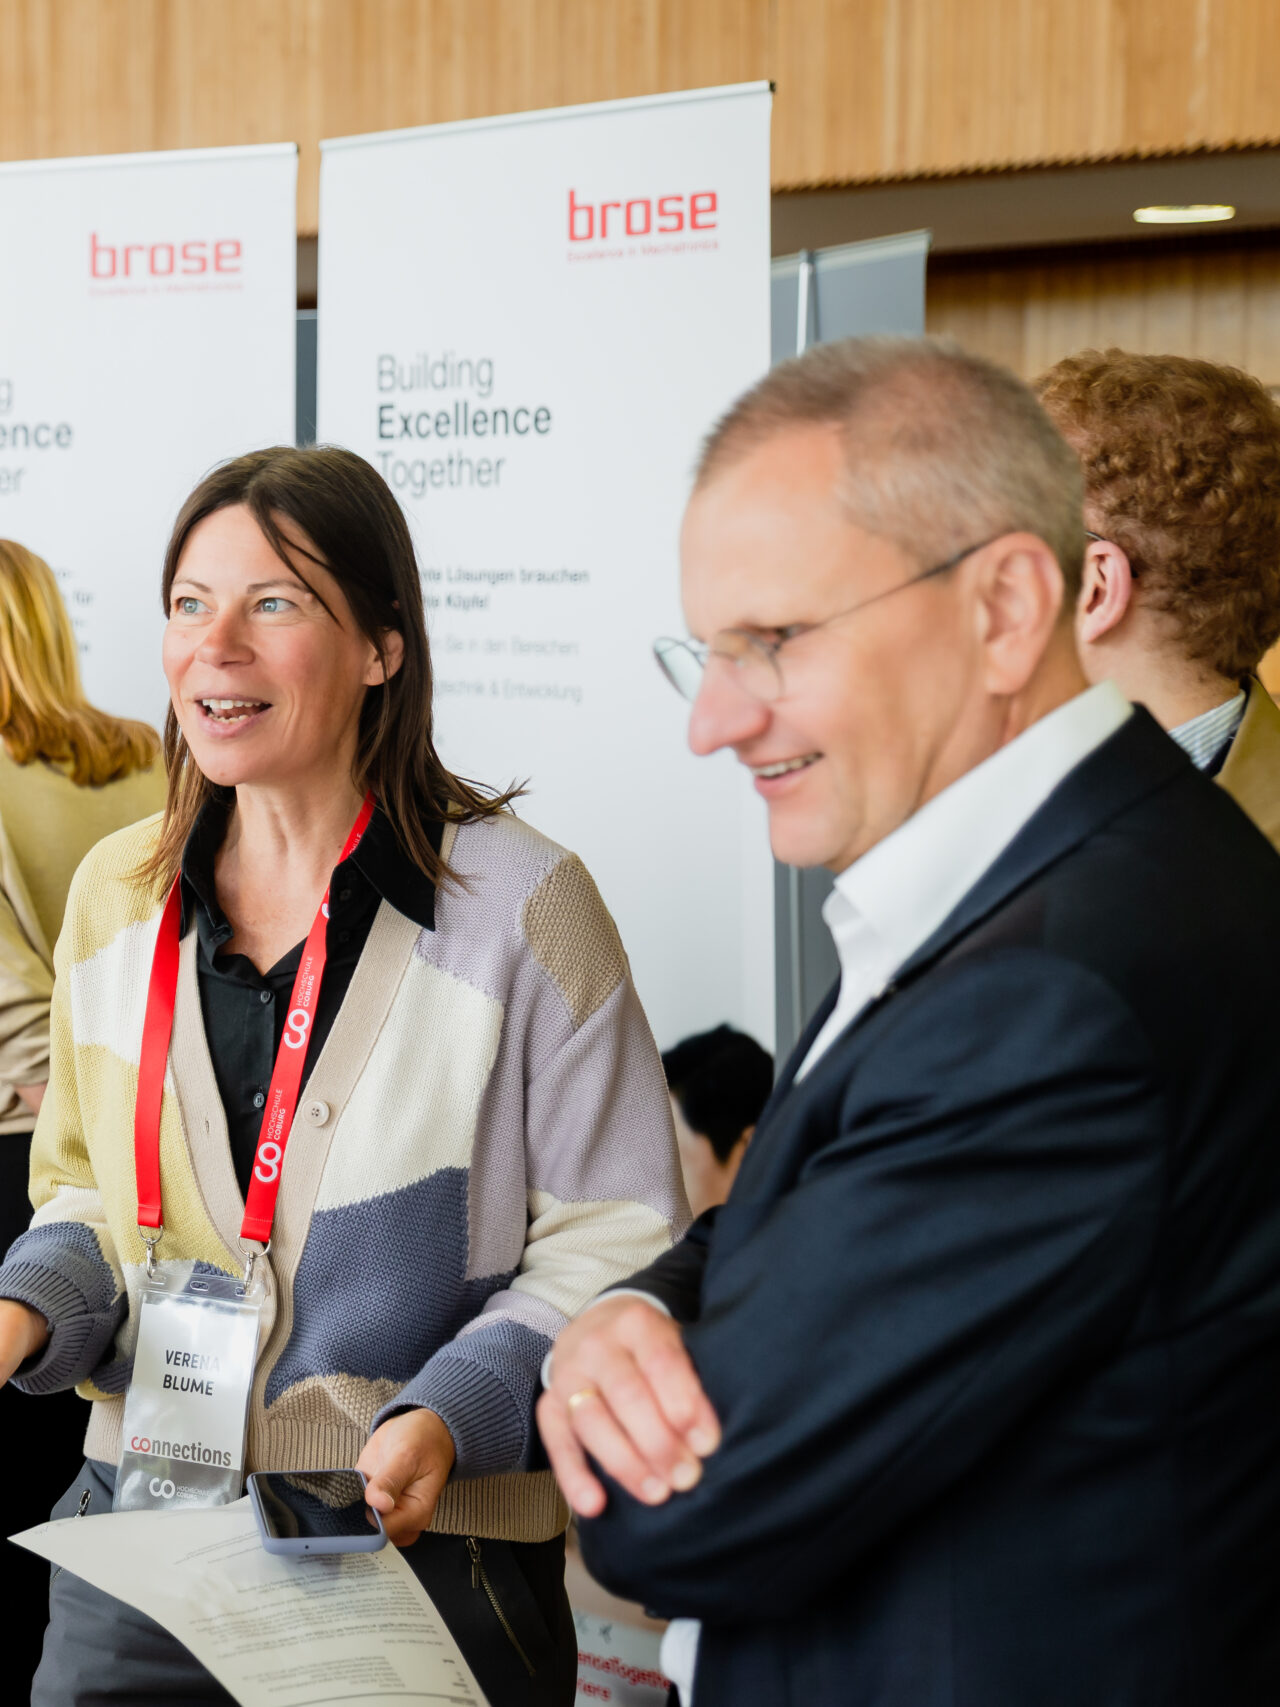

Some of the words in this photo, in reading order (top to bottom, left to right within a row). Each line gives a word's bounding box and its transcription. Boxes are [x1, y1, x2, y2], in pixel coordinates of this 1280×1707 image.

[568, 188, 719, 241] brose
[88, 231, 243, 280] brose
[377, 352, 495, 398] Building
[377, 401, 553, 440] Excellence
[377, 449, 506, 499] Together
[448, 567, 514, 586] Lösungen
[520, 567, 589, 582] brauchen
[297, 956, 314, 1006] HOCHSCHULE
[302, 975, 315, 1007] COBURG
[266, 1088, 283, 1139] HOCHSCHULE
[273, 1108, 286, 1140] COBURG
[163, 1375, 213, 1395] BLUME
[130, 1435, 232, 1467] connections
